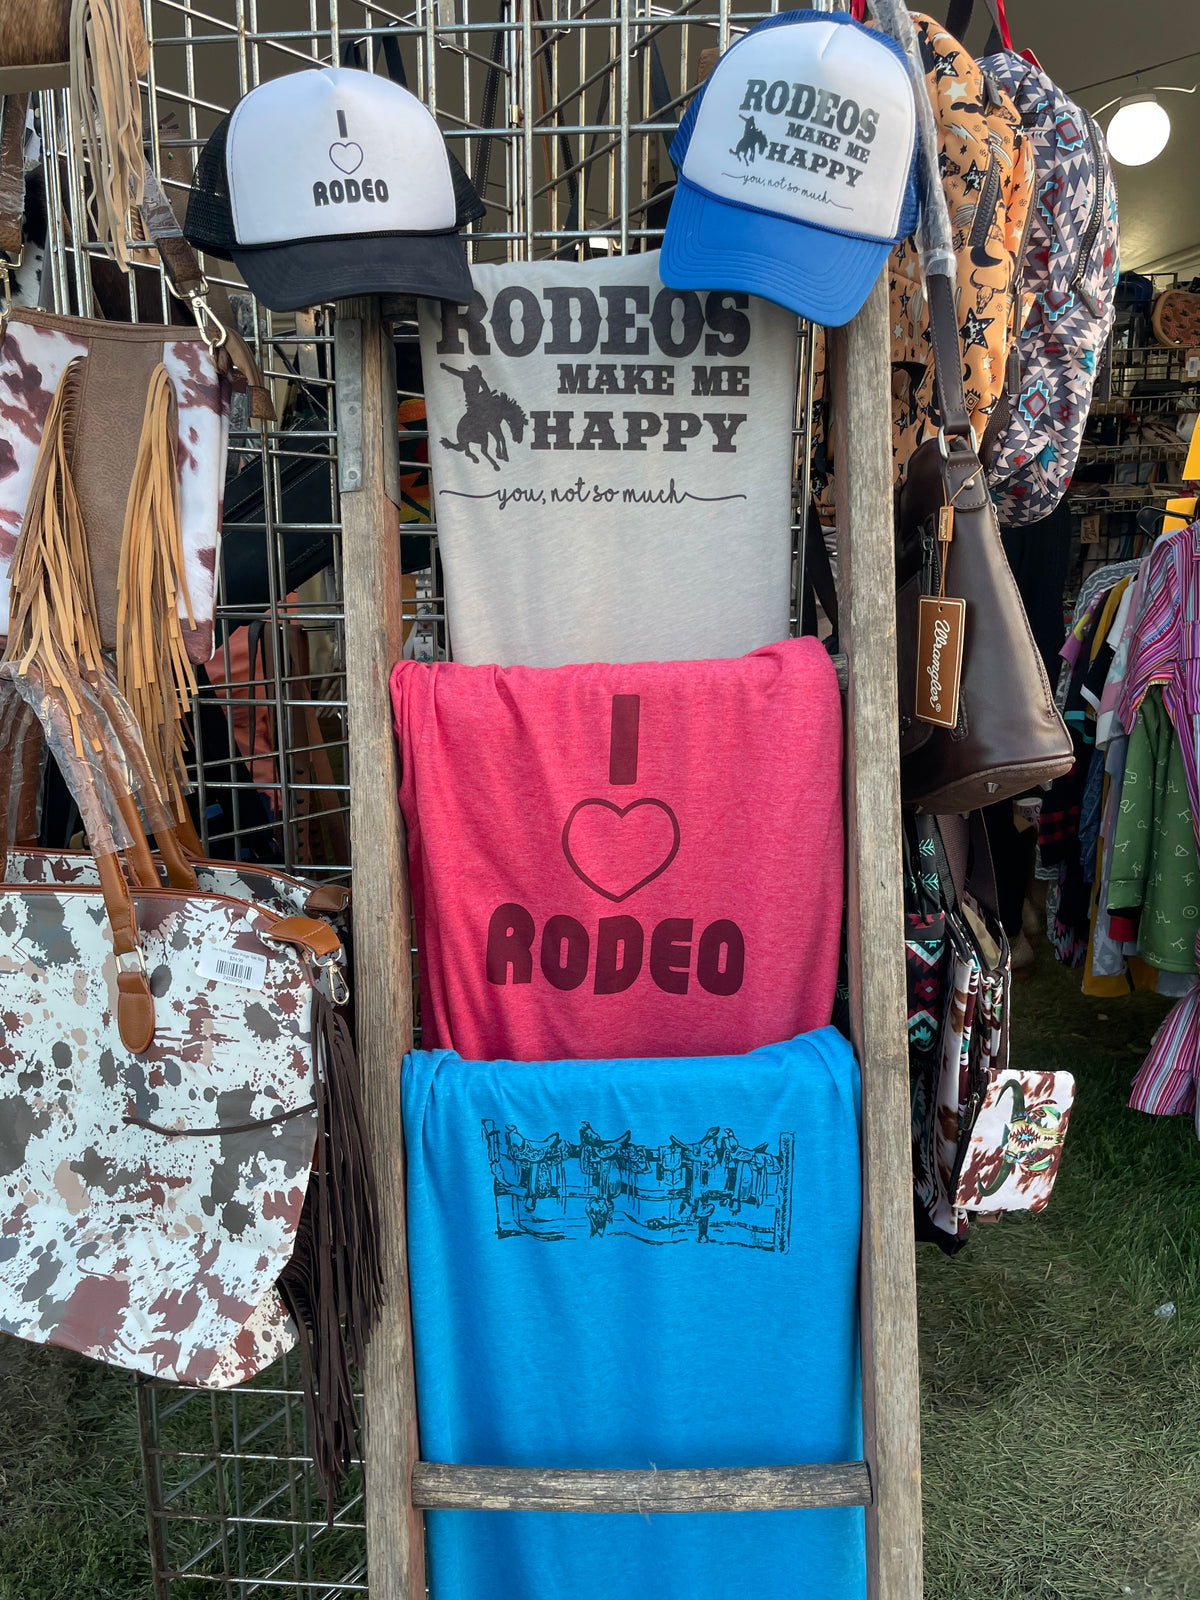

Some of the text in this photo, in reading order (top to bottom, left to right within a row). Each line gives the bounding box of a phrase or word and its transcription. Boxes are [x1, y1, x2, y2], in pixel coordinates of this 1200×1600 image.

[336, 109, 348, 138] I
[739, 79, 880, 144] RODEOS
[765, 141, 863, 187] HAPPY
[785, 121, 871, 164] MAKE ME
[312, 178, 389, 207] RODEO
[768, 176, 787, 189] not
[787, 184, 800, 193] so
[801, 188, 831, 204] much
[436, 285, 750, 358] RODEOS
[557, 363, 750, 396] MAKE ME
[530, 410, 747, 453] HAPPY
[550, 476, 591, 503] not
[592, 484, 619, 503] so
[622, 478, 687, 503] much
[608, 694, 640, 785] I
[485, 902, 745, 996] RODEO
